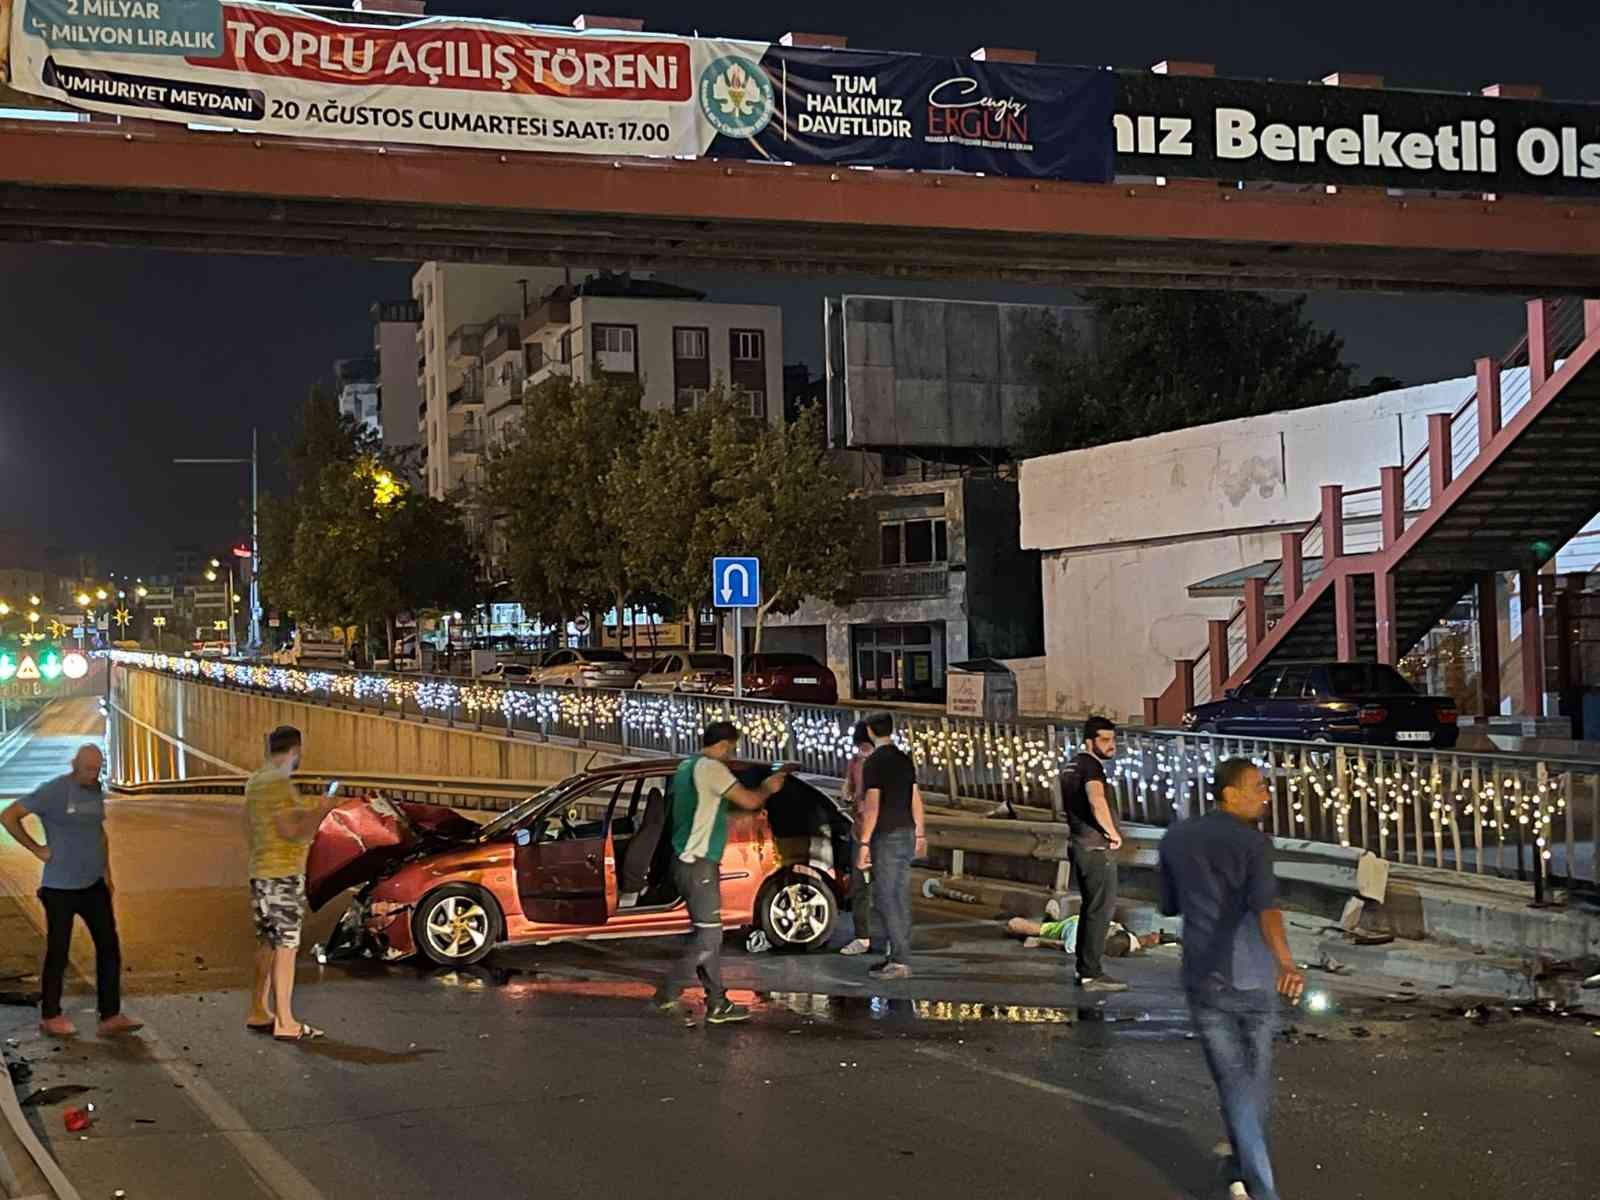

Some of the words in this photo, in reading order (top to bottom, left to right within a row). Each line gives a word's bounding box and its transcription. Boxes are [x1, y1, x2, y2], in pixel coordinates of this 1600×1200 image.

[66, 0, 78, 16] 2
[226, 20, 374, 74] TOPLU
[384, 40, 518, 90] AÇILIŞ
[57, 70, 168, 102] UMHURİYET
[271, 99, 299, 120] 20
[305, 100, 413, 128] AĞUSTOS
[552, 119, 614, 140] SAAT:
[618, 121, 670, 142] 17.00
[806, 93, 903, 117] HALKIMIZ
[1215, 107, 1498, 174] Bereketli
